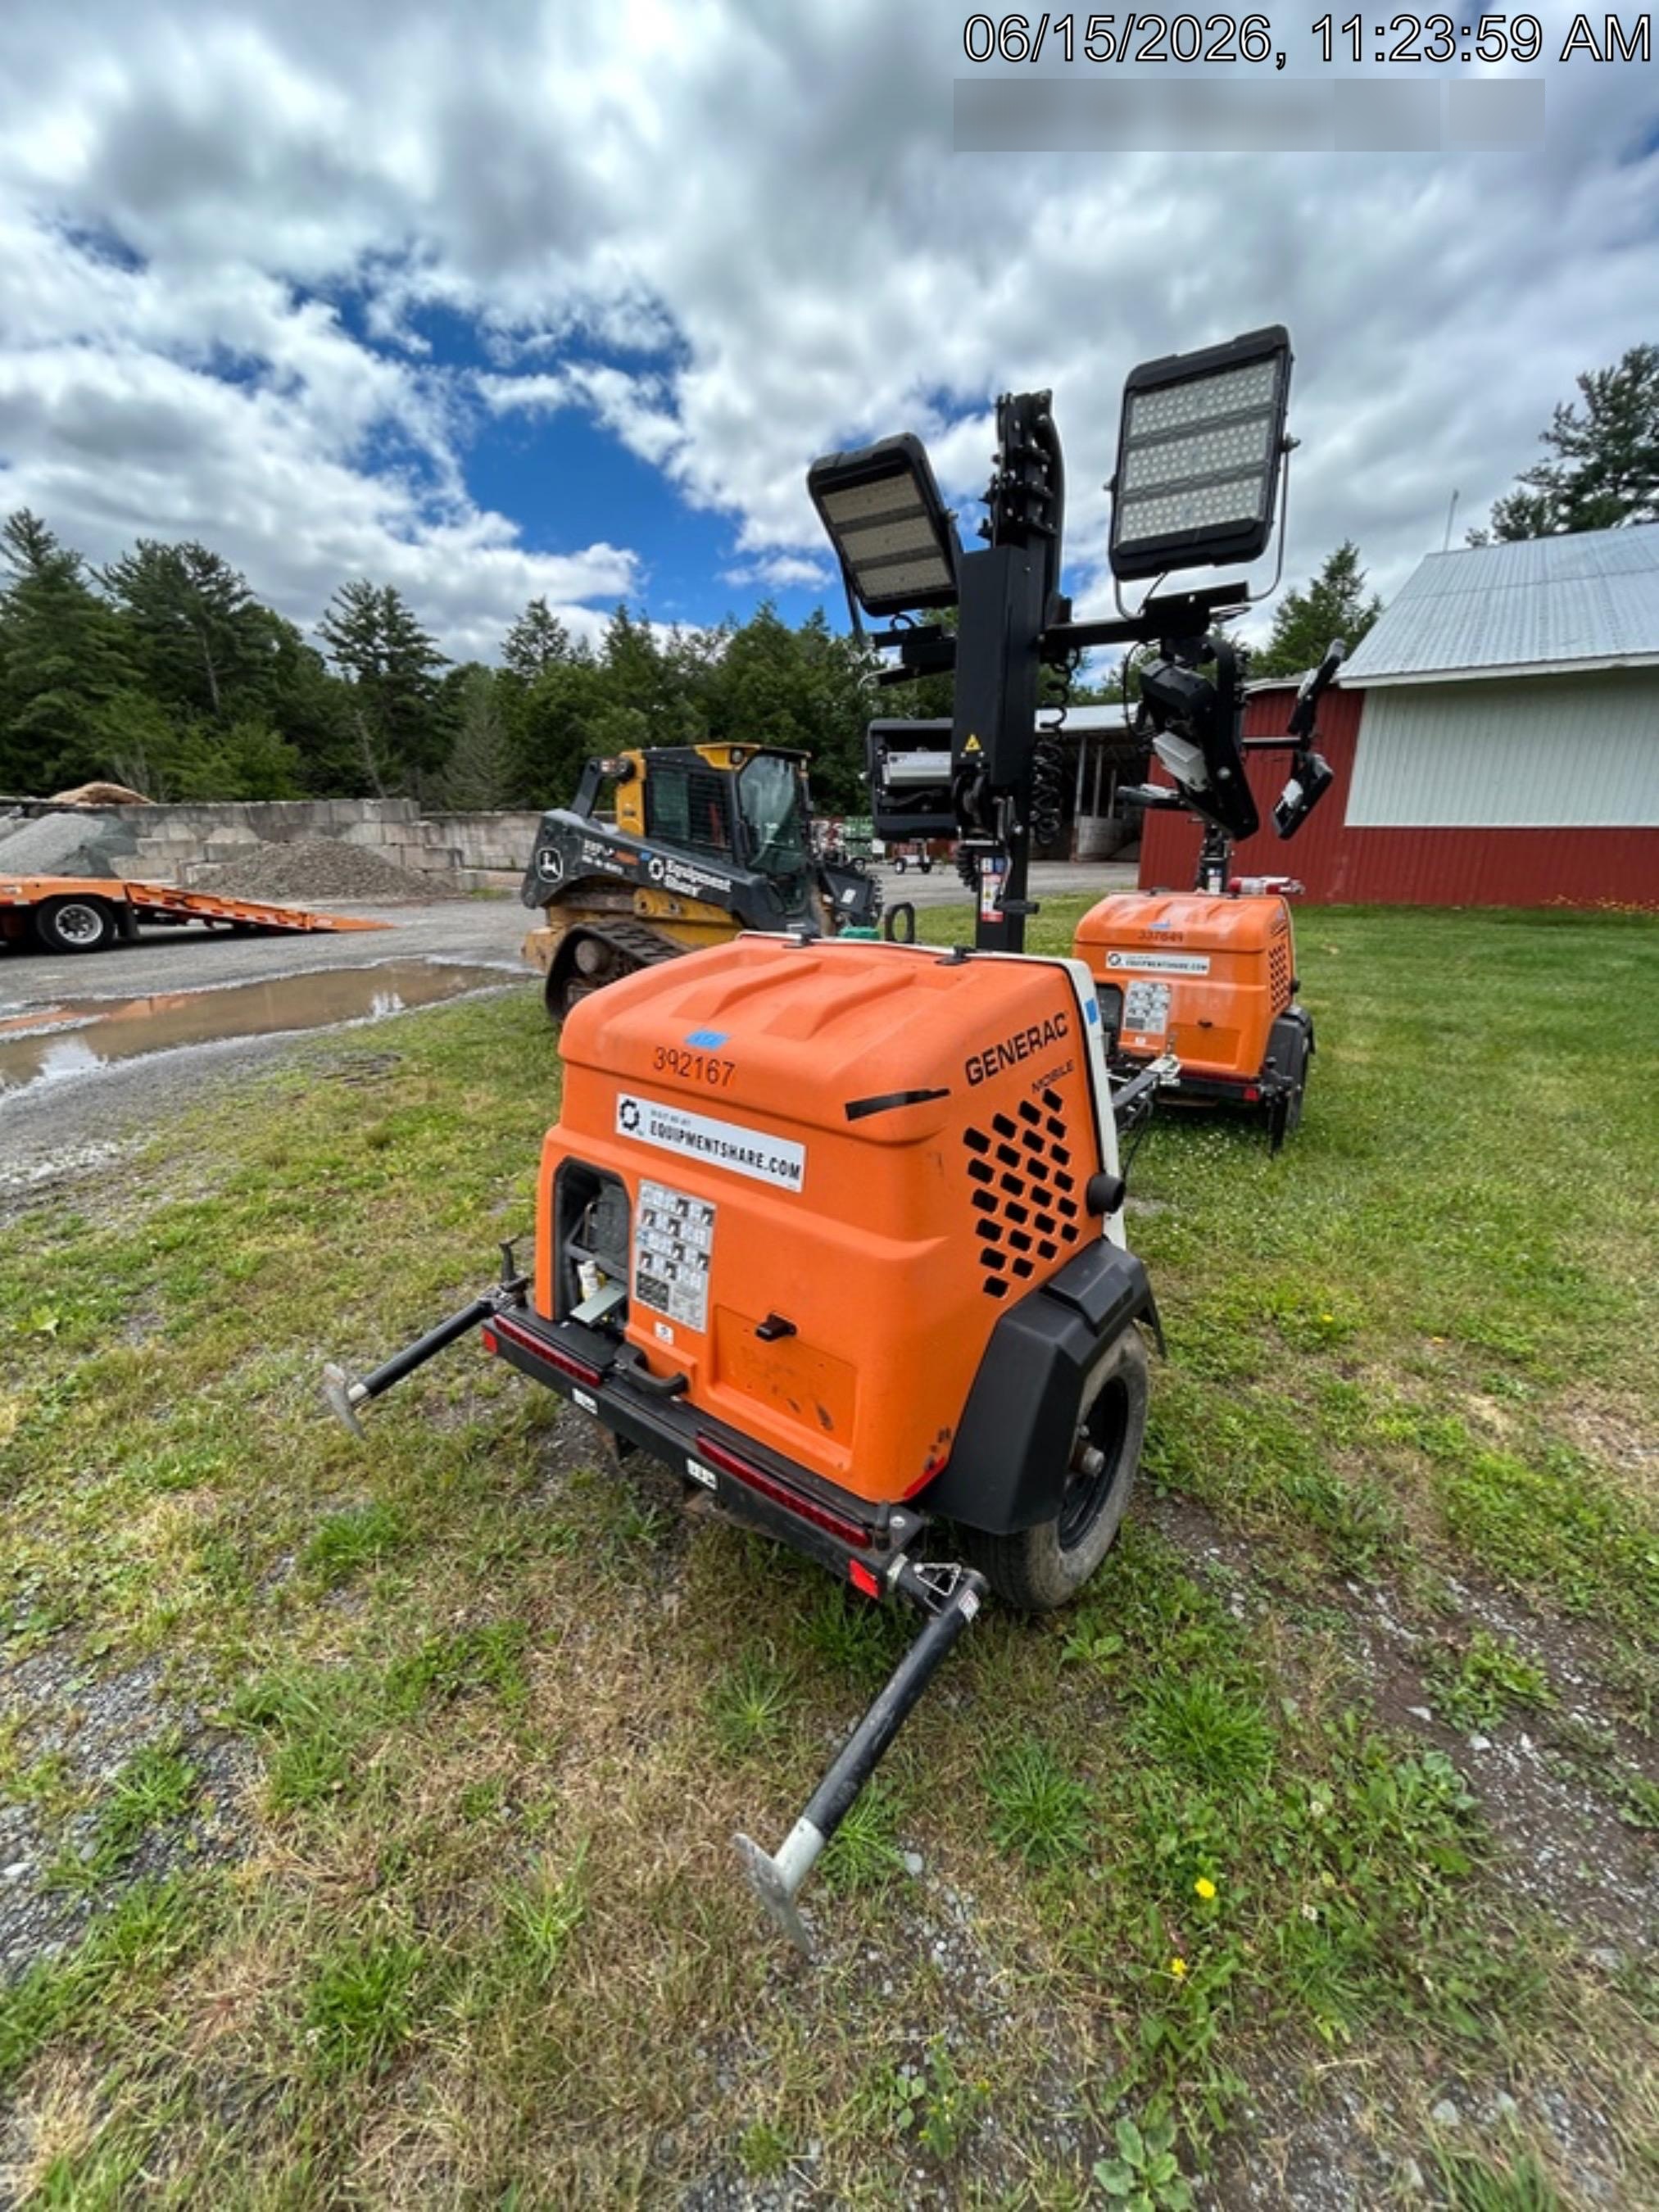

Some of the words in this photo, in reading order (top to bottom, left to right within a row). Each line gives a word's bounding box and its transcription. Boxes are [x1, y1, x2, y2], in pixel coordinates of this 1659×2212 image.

[654, 1046, 736, 1087] 392167
[964, 1012, 1068, 1086] GENERAC
[1031, 1058, 1075, 1095] MOBILE
[650, 1120, 801, 1181] EQUIPMENTSHARE.COM
